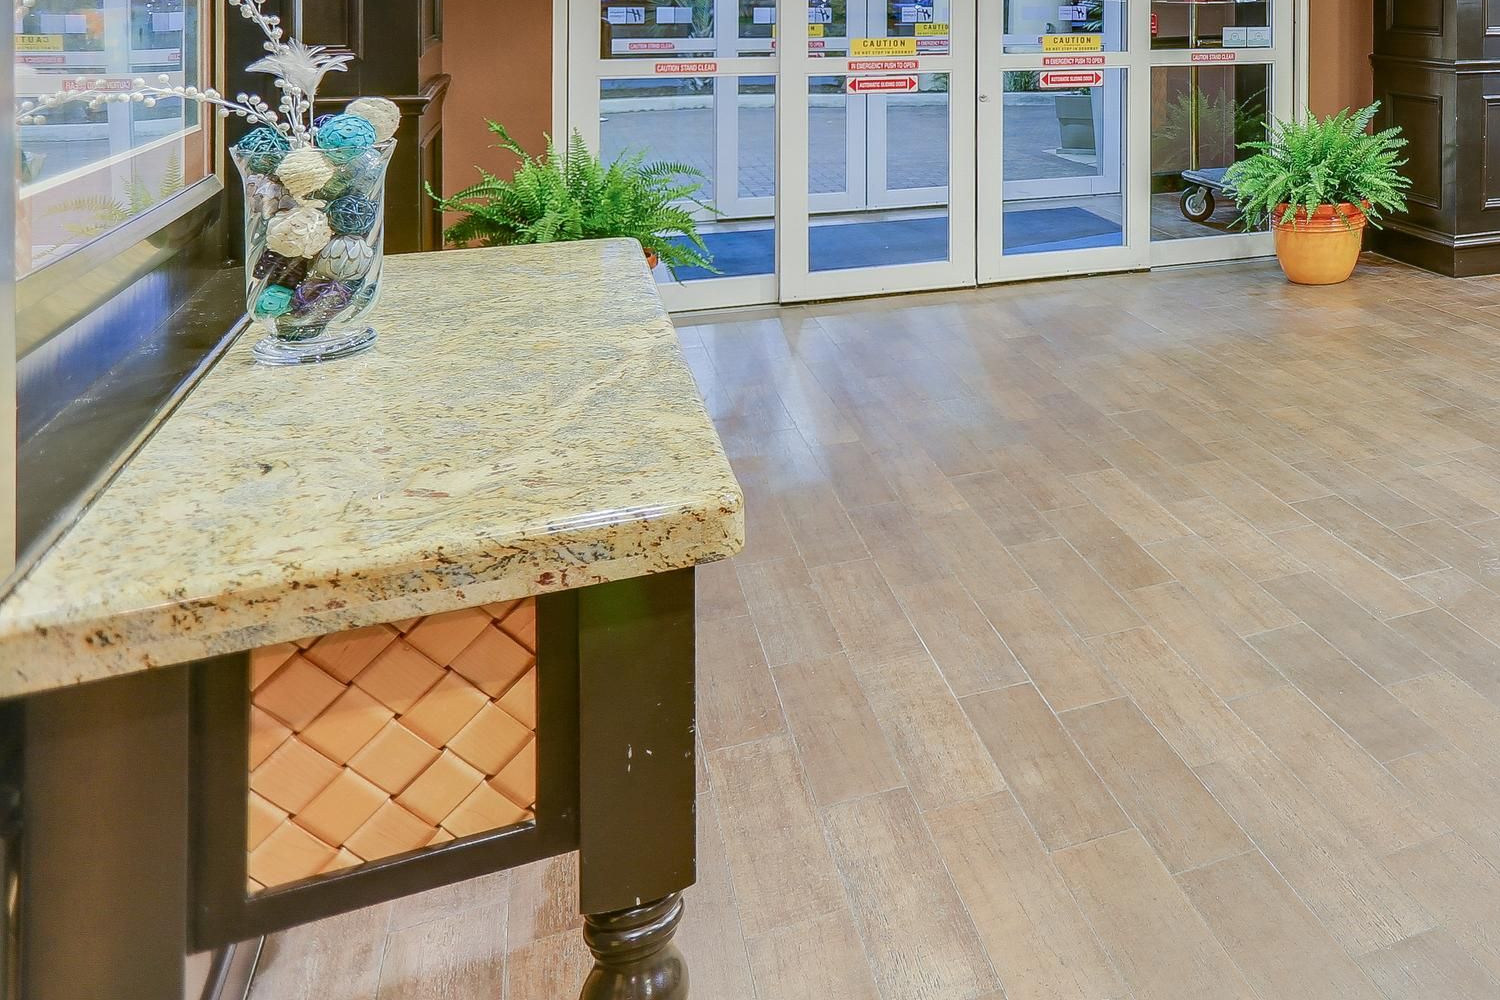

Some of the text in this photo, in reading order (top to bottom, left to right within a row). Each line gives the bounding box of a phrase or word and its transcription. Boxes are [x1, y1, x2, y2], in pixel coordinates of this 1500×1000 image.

[862, 40, 906, 48] CAUTION
[657, 63, 715, 72] CAUTION STAND CLEAR
